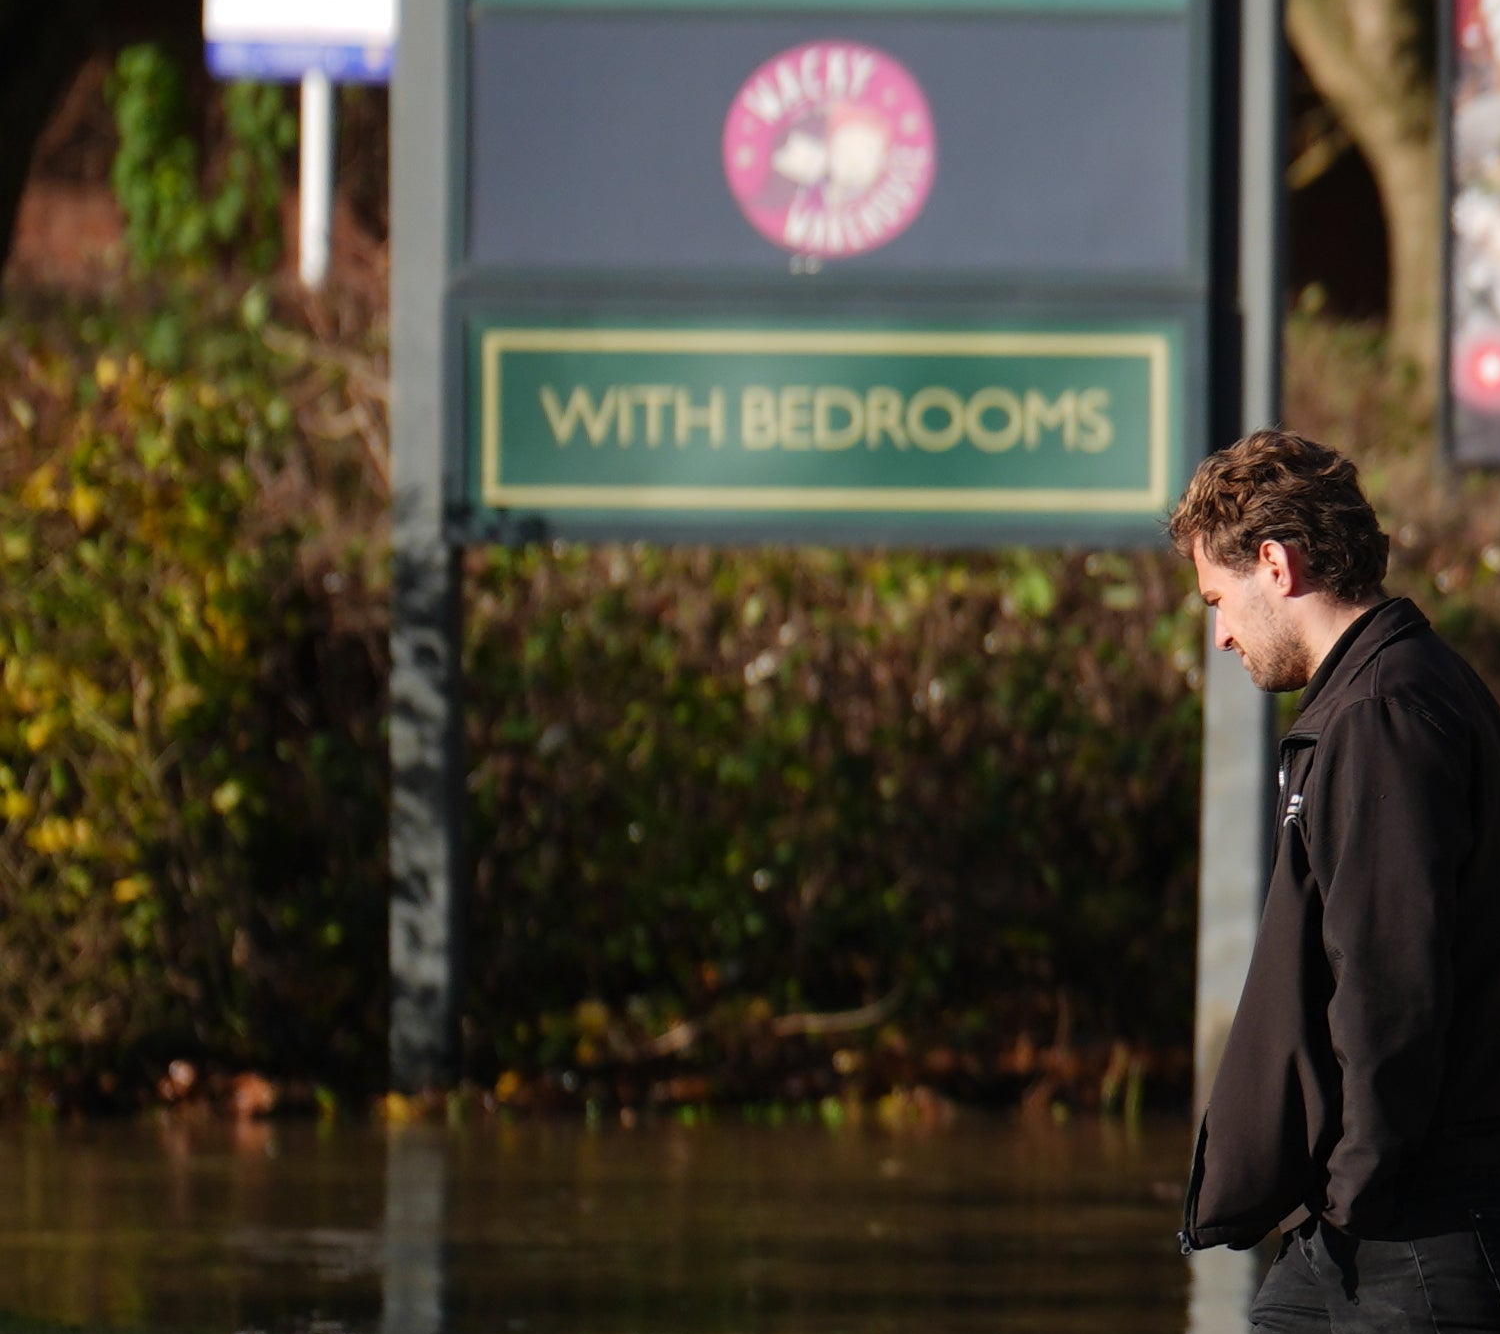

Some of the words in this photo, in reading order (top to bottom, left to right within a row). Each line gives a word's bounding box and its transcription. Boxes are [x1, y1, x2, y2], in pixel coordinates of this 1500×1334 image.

[742, 47, 874, 125] WACKY
[537, 384, 726, 451] WITH
[739, 384, 1115, 454] BEDROOMS
